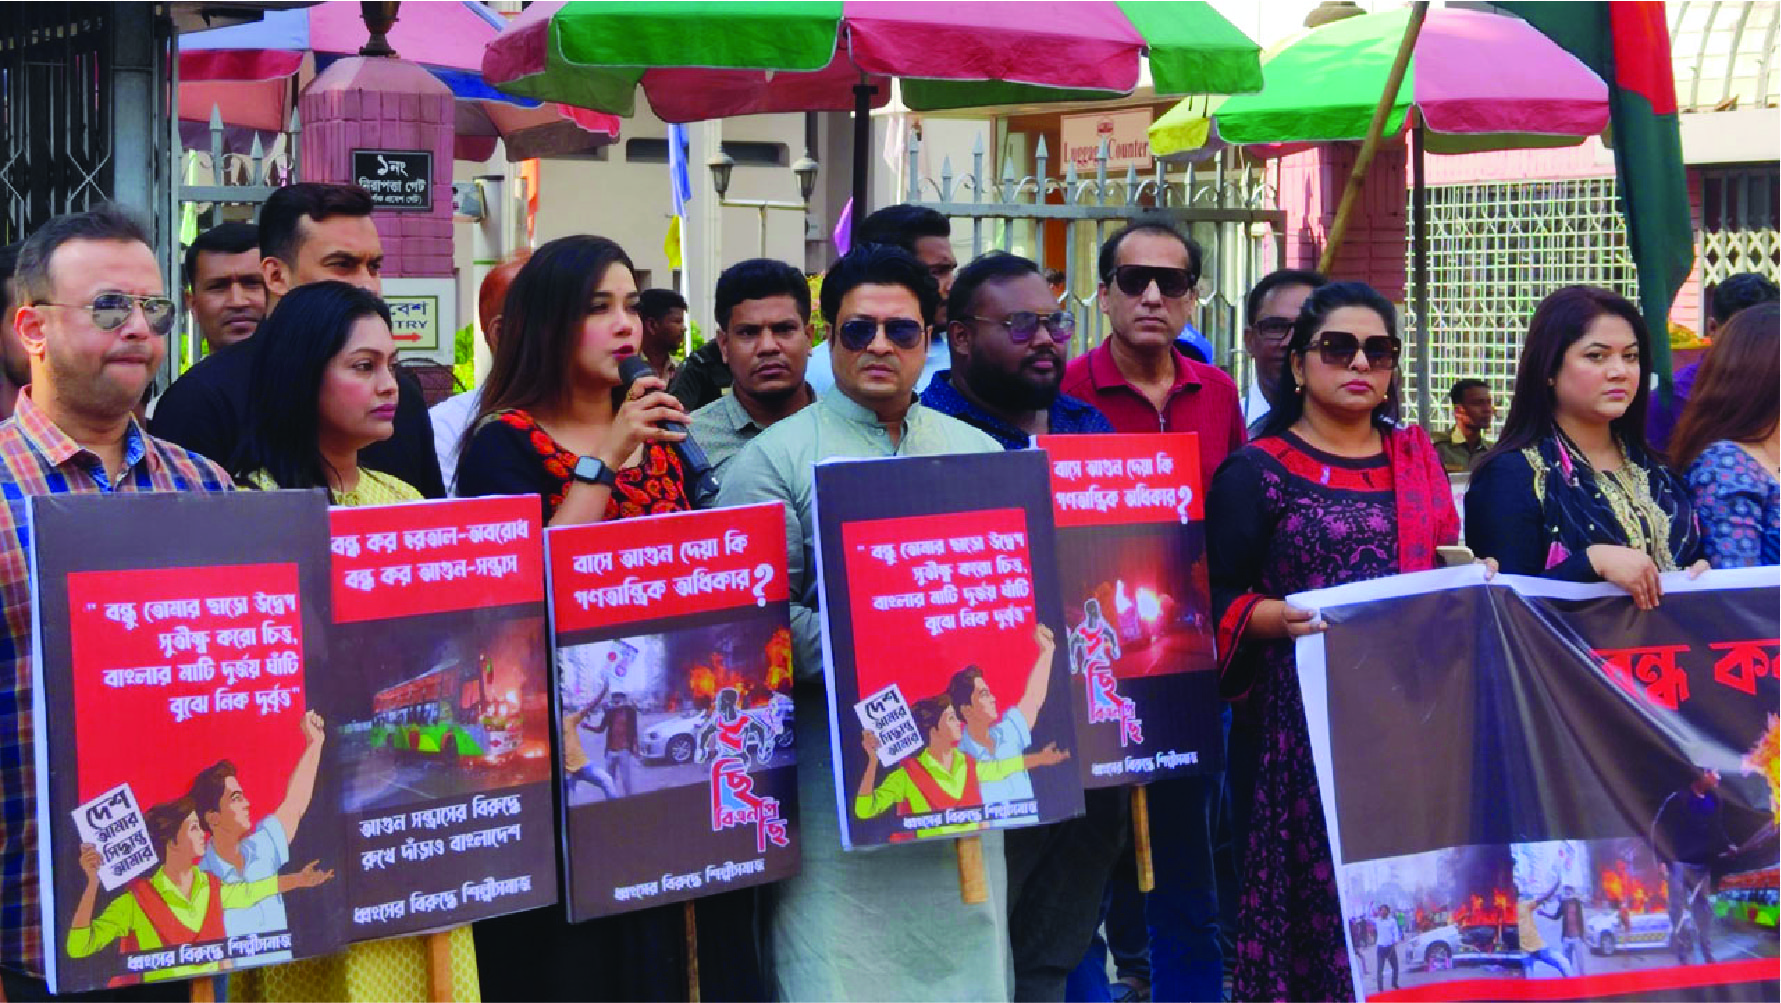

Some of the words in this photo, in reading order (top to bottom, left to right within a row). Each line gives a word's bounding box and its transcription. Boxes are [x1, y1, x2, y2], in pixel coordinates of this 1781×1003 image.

[377, 154, 409, 176] ১নং
[1063, 142, 1104, 166] Luggag
[1107, 138, 1148, 160] Counter
[405, 178, 426, 192] গেট
[388, 301, 429, 317] বেশ
[393, 320, 428, 329] TRY
[1053, 460, 1082, 481] বাসে
[1085, 459, 1123, 478] আগুন
[1127, 458, 1153, 480] দেয়া
[1156, 452, 1174, 475] কি
[1055, 484, 1118, 513] গণতান্ত্রিক
[331, 534, 361, 557] বন্ধ
[365, 531, 398, 553] কর
[572, 551, 613, 575] বাসে
[618, 544, 673, 569] আগুন
[679, 538, 719, 564] দেয়া
[724, 529, 748, 556] কি
[870, 543, 898, 567] বন্ধু
[900, 538, 945, 560] তোমার
[344, 568, 376, 591] বন্ধ
[380, 564, 412, 587] কর
[957, 561, 993, 579] করো
[573, 577, 667, 610] গণতান্ত্রিক
[872, 591, 926, 612] বাংলার
[929, 583, 959, 606] মাটি
[103, 602, 138, 630] বন্ধু
[144, 598, 200, 624] তোমার
[205, 595, 248, 619] ছাড়ো
[252, 591, 296, 615] উদ্বেগ
[924, 613, 956, 638] বুঝে
[959, 606, 989, 628] নিক
[216, 627, 257, 650] করো
[102, 665, 172, 688] বাংলার
[178, 655, 215, 682] মাটি
[1708, 638, 1780, 696] ক
[168, 695, 210, 723] বুঝে
[214, 687, 249, 712] নিক
[865, 690, 900, 721] দেশ
[86, 790, 132, 831] দেশ
[359, 814, 406, 838] আগুন
[411, 804, 467, 830] সন্ত্রাসের
[472, 794, 522, 819] বিরুদ্ধে
[96, 812, 139, 843] আমার
[360, 847, 396, 872] রুখে
[401, 837, 445, 861] দাঁড়াও
[449, 824, 522, 852] বাংলাদেশ
[661, 872, 702, 891] বিরুদ্ধে
[353, 901, 406, 924] ধ্বংসের
[409, 890, 459, 914] বিরুদ্ধে
